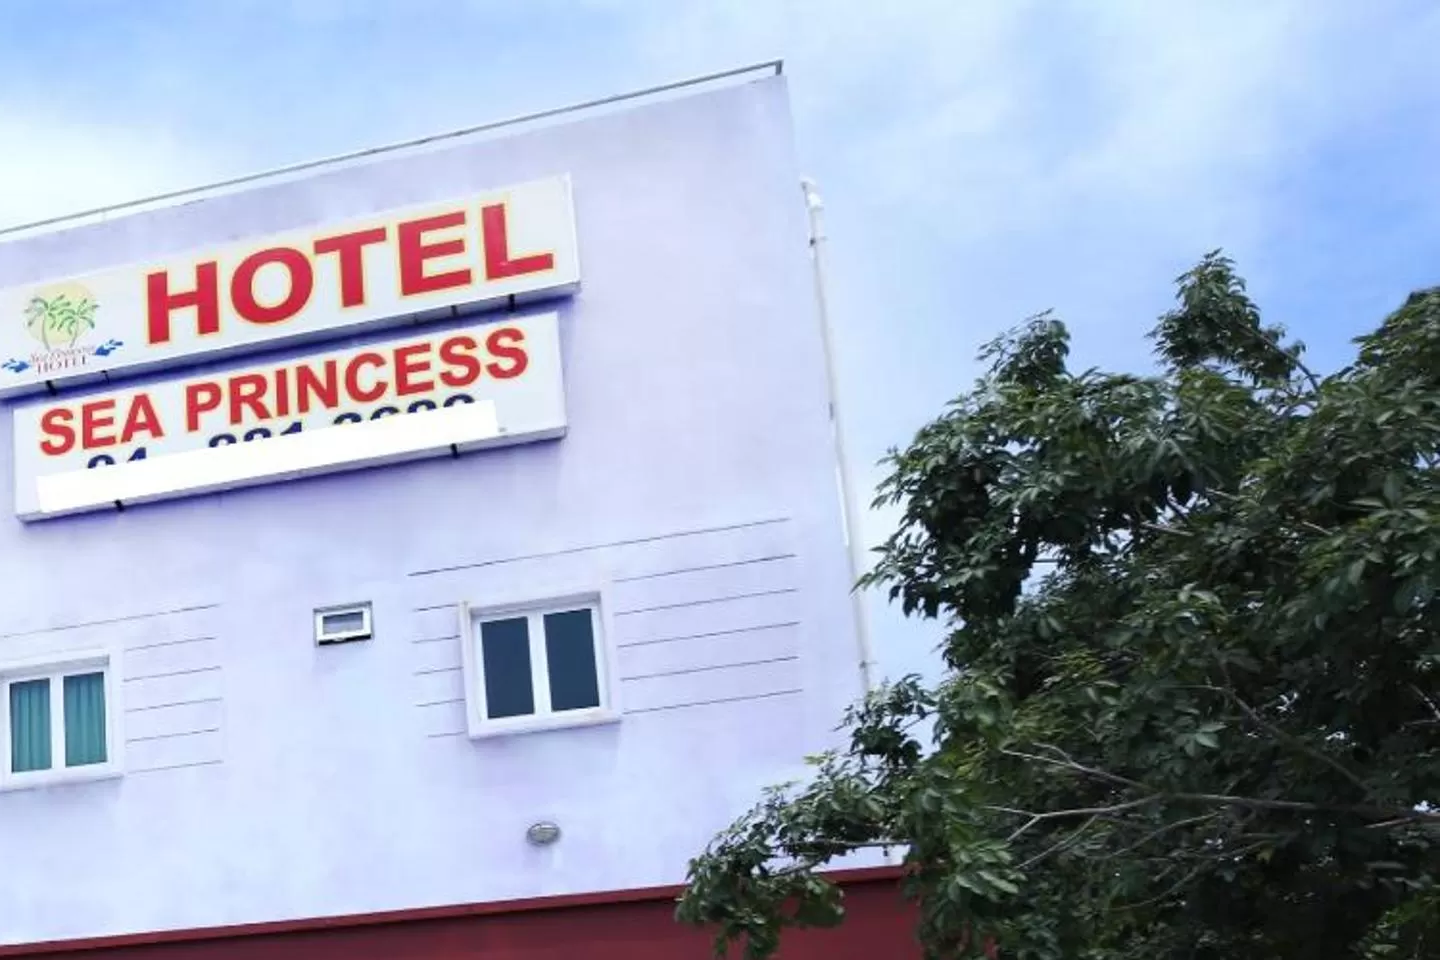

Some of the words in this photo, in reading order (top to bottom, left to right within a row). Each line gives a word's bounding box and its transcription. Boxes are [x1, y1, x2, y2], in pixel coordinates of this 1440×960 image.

[144, 201, 556, 346] HOTEL
[39, 393, 165, 457] SEA
[186, 326, 530, 433] PRINCESS
